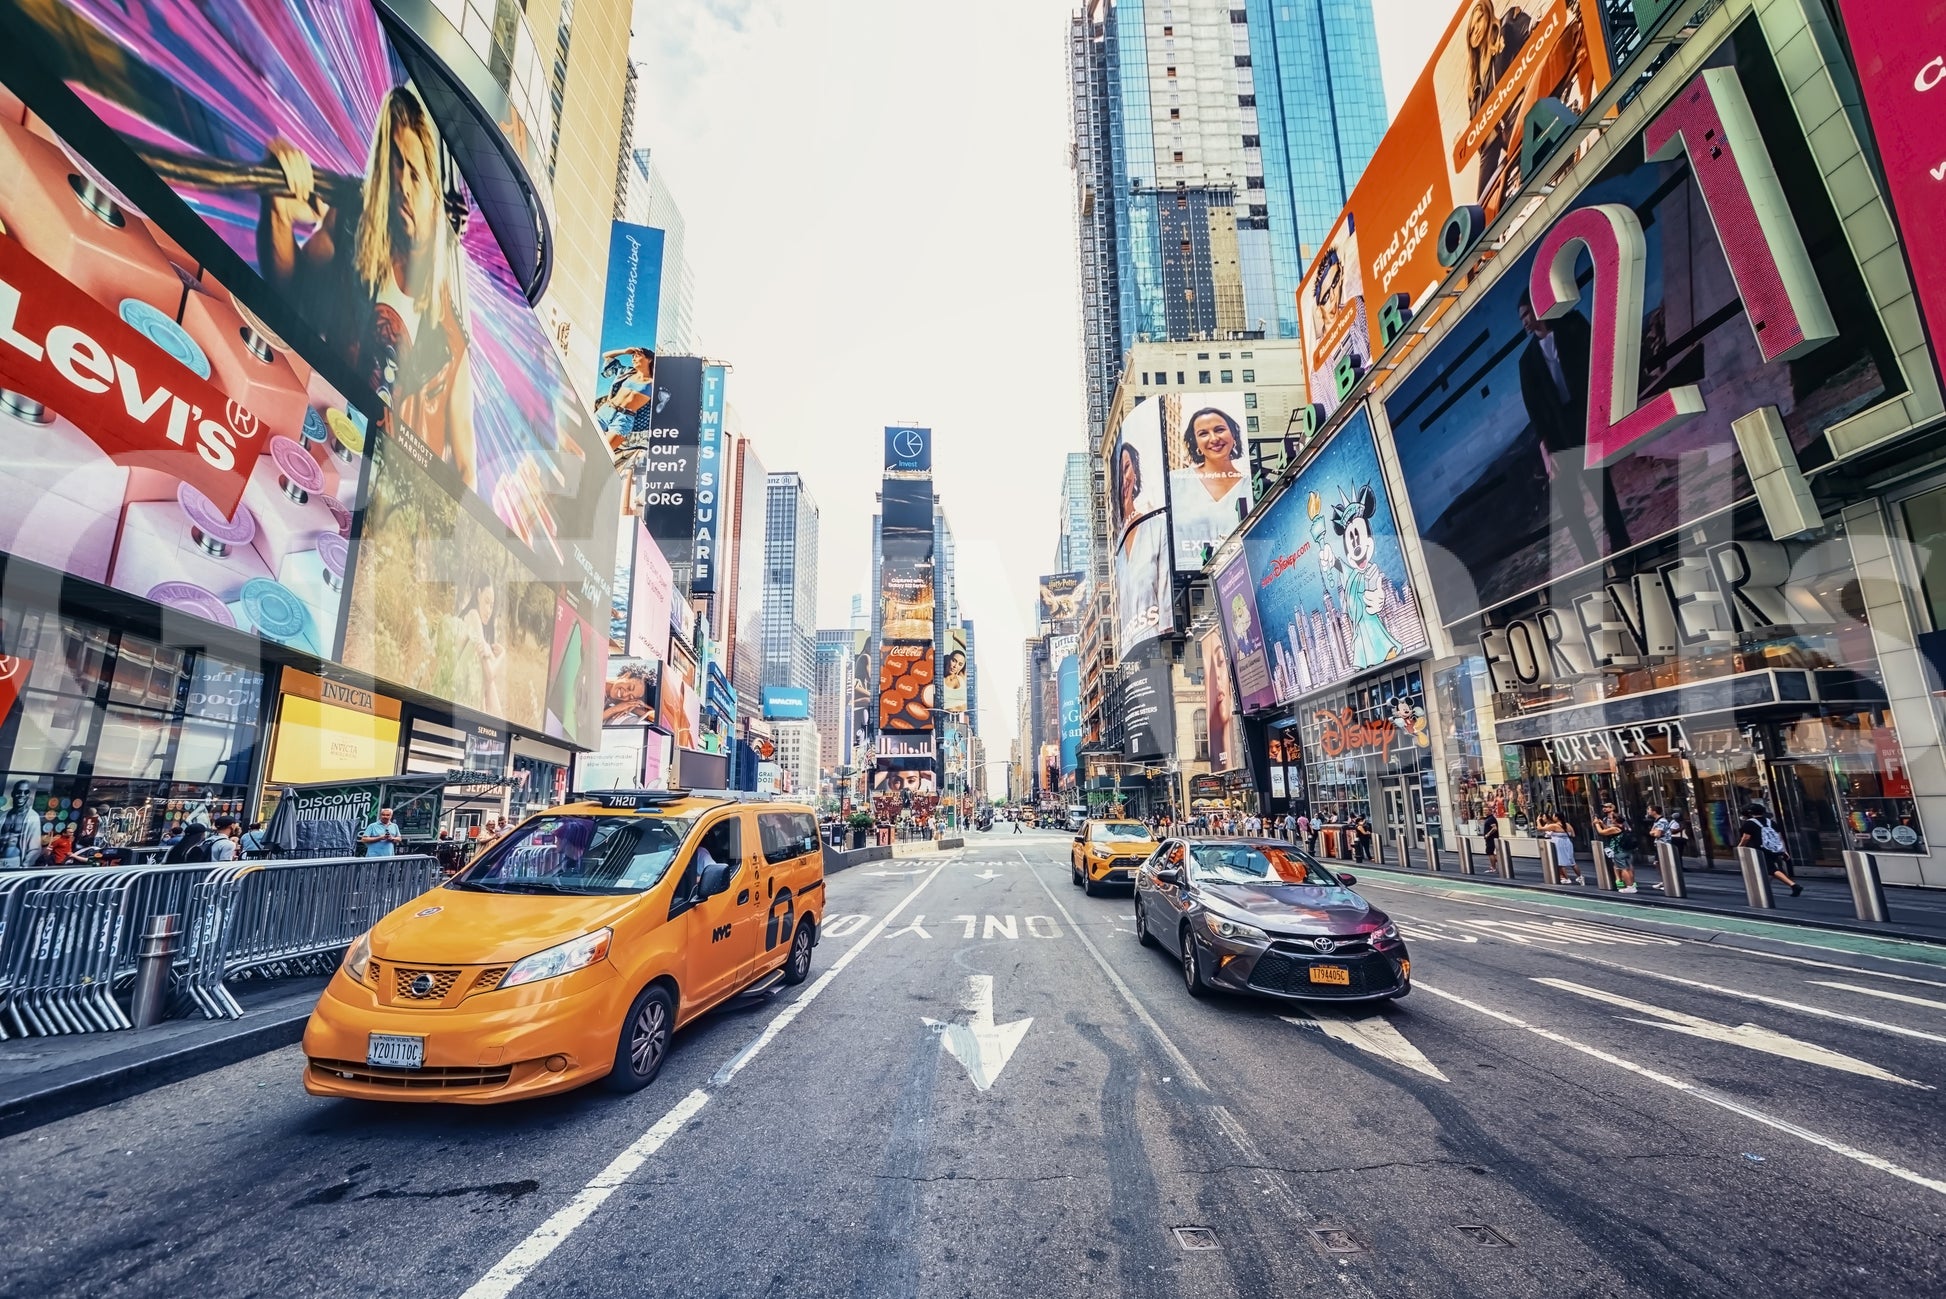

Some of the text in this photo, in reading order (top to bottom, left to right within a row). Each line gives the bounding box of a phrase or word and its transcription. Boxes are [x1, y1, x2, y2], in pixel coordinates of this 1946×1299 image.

[1373, 184, 1434, 280] Find your
[1382, 220, 1429, 293] people
[625, 235, 642, 327] unsubscribed
[399, 436, 428, 468] MARQUIS
[400, 424, 433, 461] MARRIOTT
[696, 377, 718, 578] TIMES SQUARE
[581, 576, 602, 608] NOW
[1479, 540, 1800, 695] FOREVER
[1055, 636, 1074, 649] LITTLE
[322, 681, 372, 709] INVICTA
[477, 726, 498, 738] SEPHORA
[1313, 706, 1395, 764] Disney
[1541, 717, 1692, 765] FOREVER 21
[330, 742, 358, 754] INVICTA
[298, 792, 372, 809] DISCOVER
[466, 783, 503, 796] SEPHORA
[609, 796, 637, 807] 7H20
[712, 922, 732, 944] NYC
[884, 915, 1065, 939] ONLY
[373, 1042, 419, 1061] Y201110C
